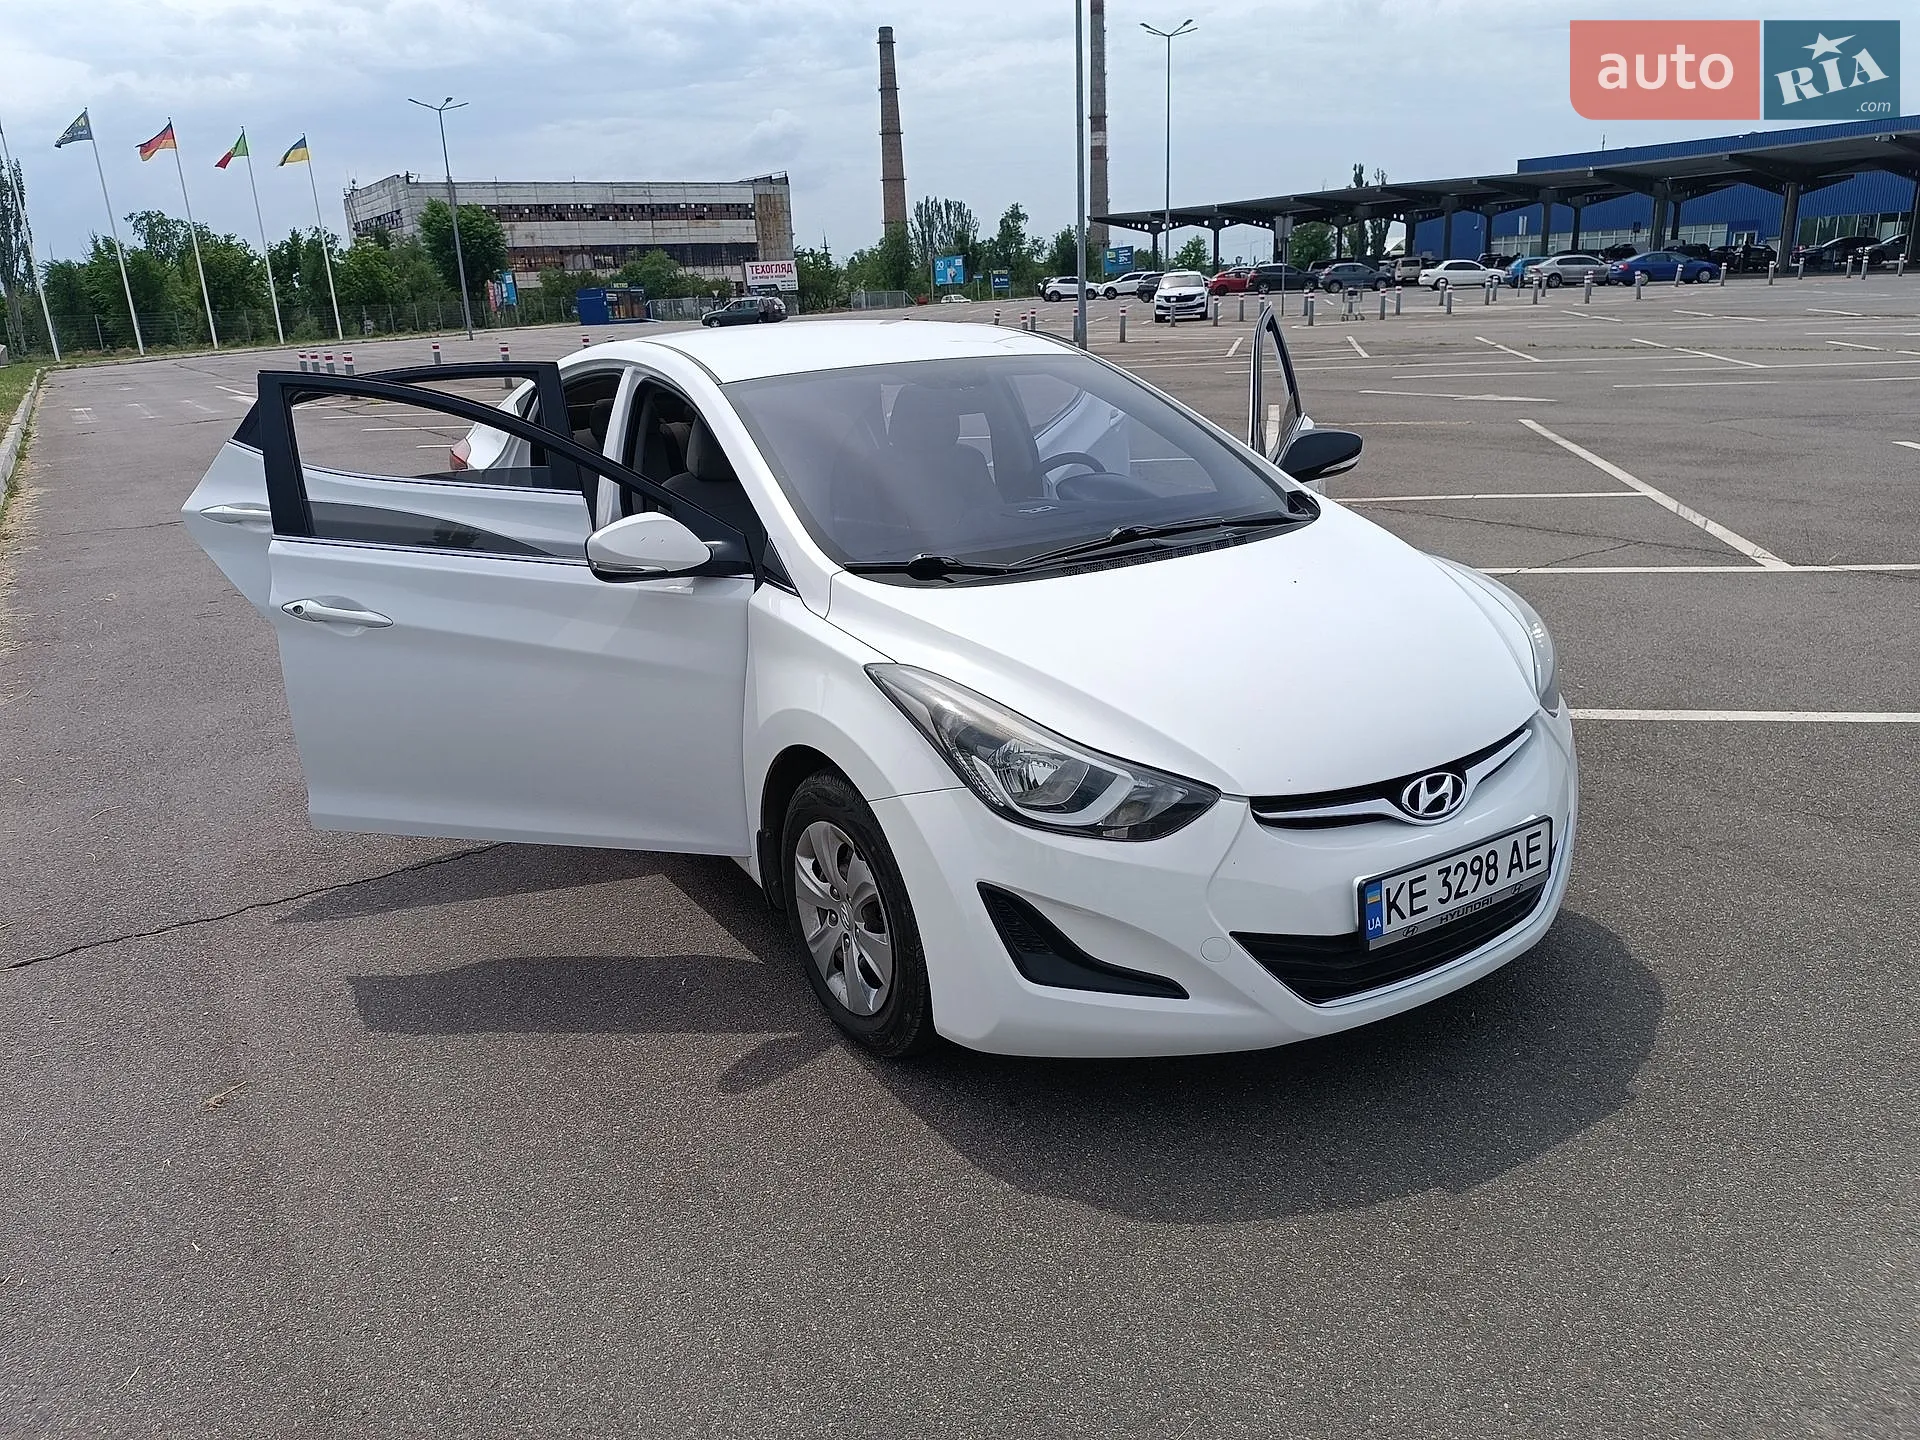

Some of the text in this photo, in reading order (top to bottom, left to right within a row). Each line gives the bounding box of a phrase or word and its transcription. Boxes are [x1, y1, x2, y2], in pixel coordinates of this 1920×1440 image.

[749, 263, 793, 275] ТЕХОГЛЯД
[1386, 830, 1542, 925] KE 3298 AE
[1439, 897, 1493, 924] HYUNDAI
[1367, 919, 1382, 931] UA
